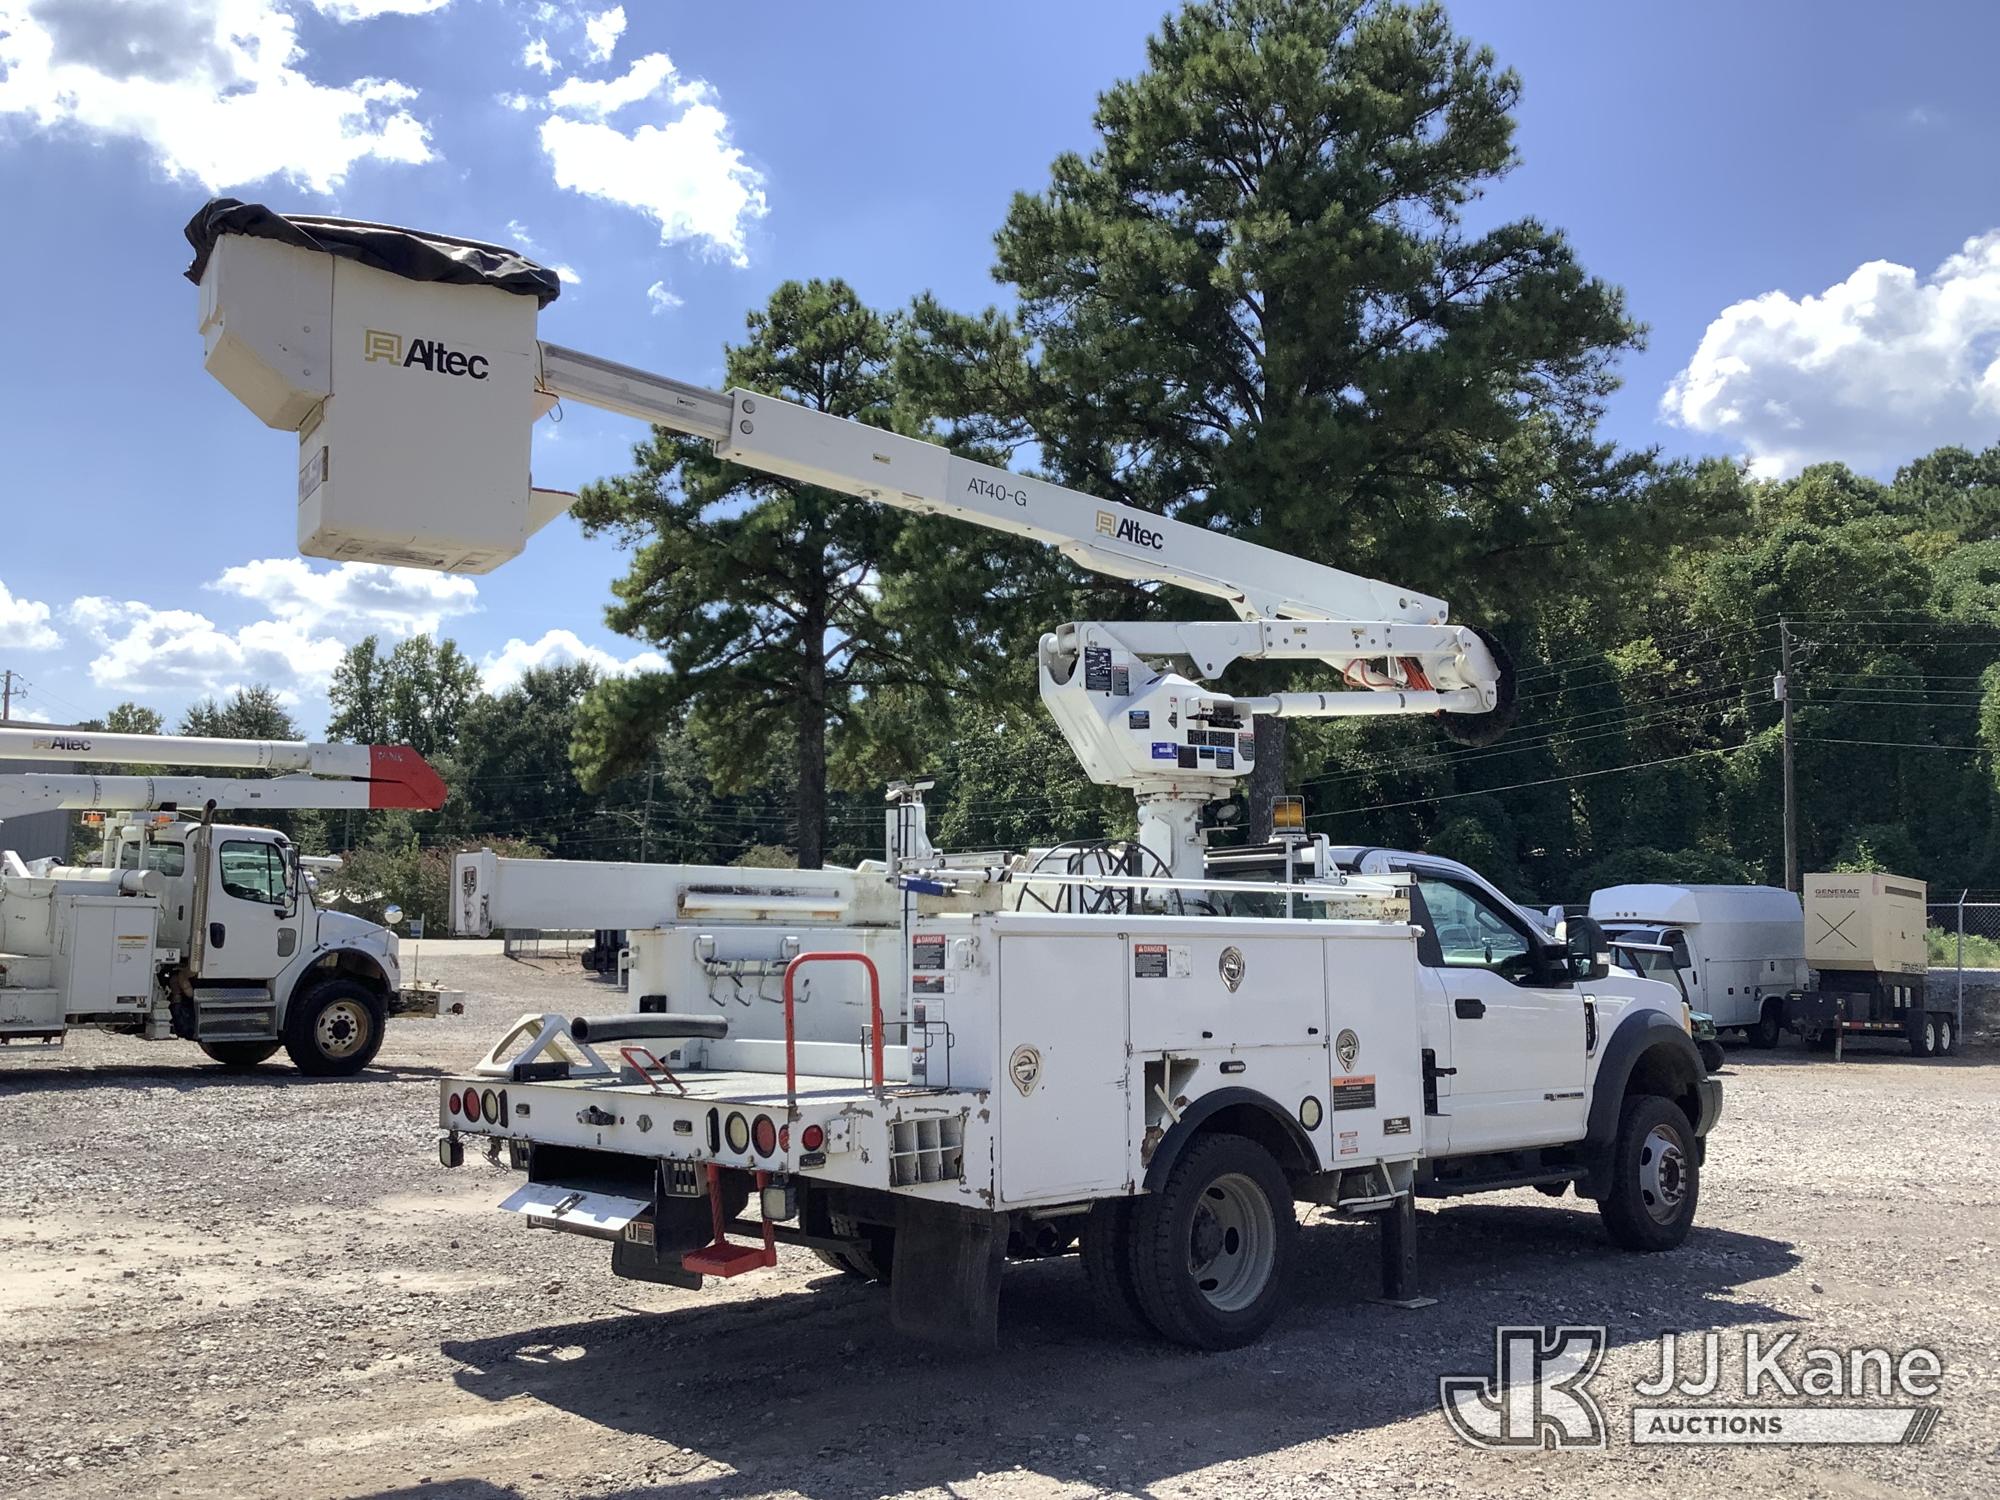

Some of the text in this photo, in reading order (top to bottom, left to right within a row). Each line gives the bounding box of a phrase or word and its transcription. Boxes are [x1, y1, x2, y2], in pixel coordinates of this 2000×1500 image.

[403, 338, 489, 380] Altec
[967, 477, 1027, 507] AT40-G
[1116, 518, 1164, 550] Altec
[51, 736, 91, 751] Altec
[921, 935, 942, 945] DANGER
[1143, 945, 1164, 953] DANGER
